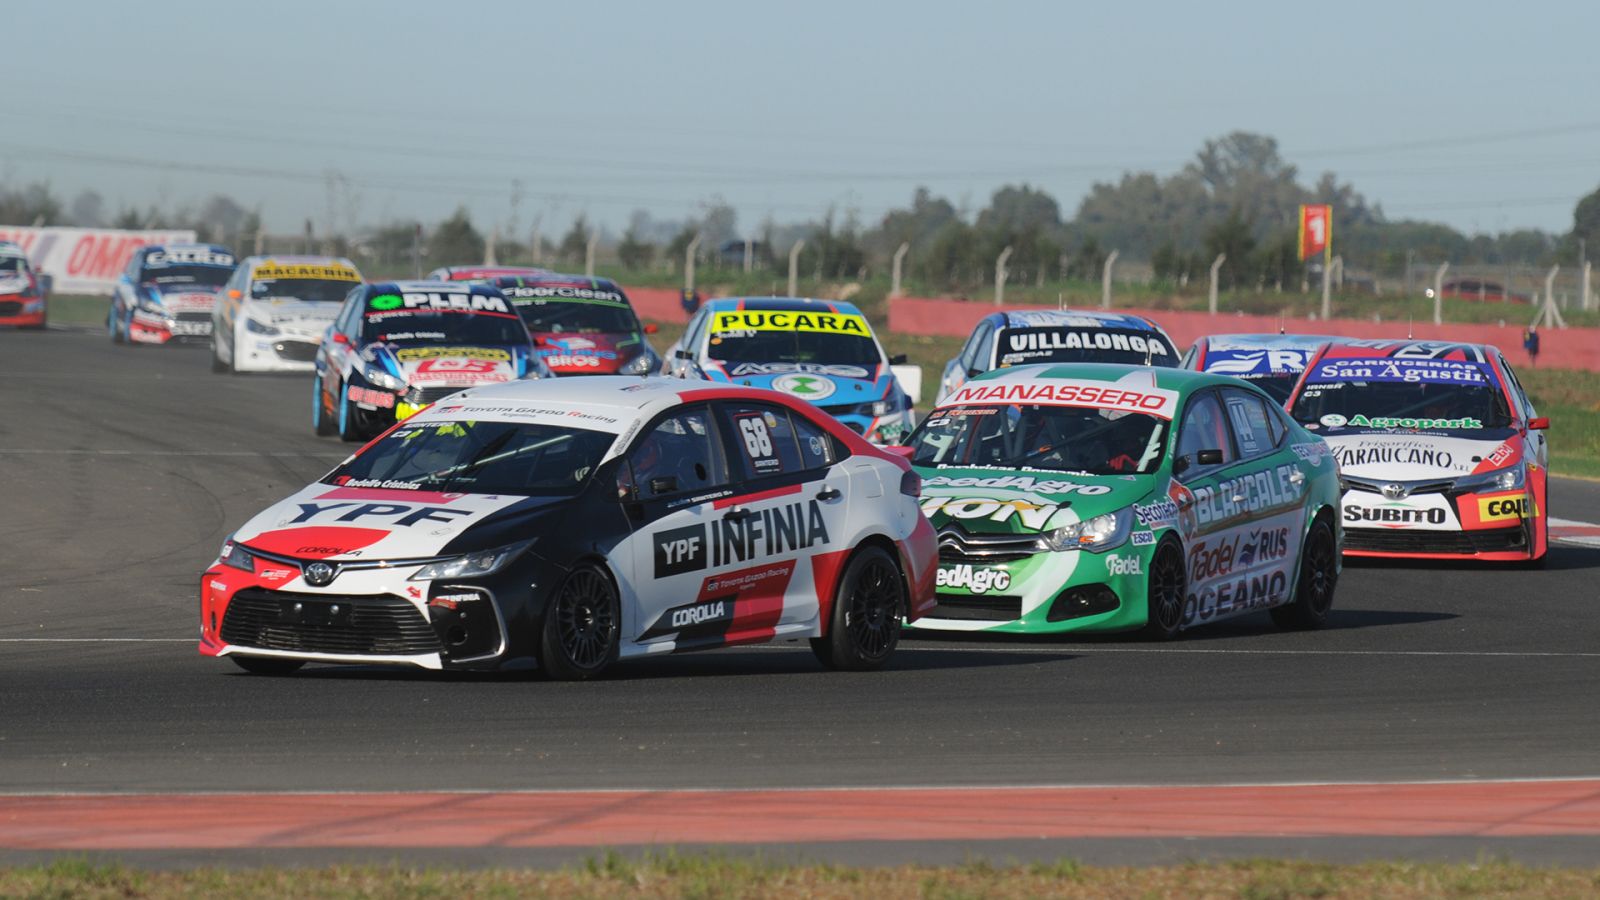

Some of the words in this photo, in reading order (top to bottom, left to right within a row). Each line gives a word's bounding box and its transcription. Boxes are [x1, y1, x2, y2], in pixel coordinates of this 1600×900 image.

[1309, 217, 1325, 244] 1
[256, 267, 355, 278] MACACHIN
[403, 294, 509, 311] PLEM
[720, 313, 864, 333] PUCARA
[1009, 332, 1168, 356] VILLALONGA
[548, 355, 600, 366] BROS
[1320, 365, 1372, 378] San
[954, 384, 1167, 411] MANASSERO
[567, 411, 617, 424] Racing
[1347, 414, 1483, 429] Agropark
[739, 417, 773, 458] 68
[1341, 447, 1452, 468] ARAUCANO
[344, 479, 382, 488] Rodolfo
[381, 480, 422, 490] Cristales
[288, 503, 474, 527] YPF
[1344, 504, 1446, 524] SUBITO
[712, 500, 830, 568] INFINIA
[1133, 531, 1154, 544] ESCO
[1260, 527, 1288, 561] RUS
[295, 546, 363, 558] COROLLA
[661, 536, 700, 565] YPF
[1184, 570, 1286, 626] OCEANO
[672, 602, 725, 627] COROLLA
